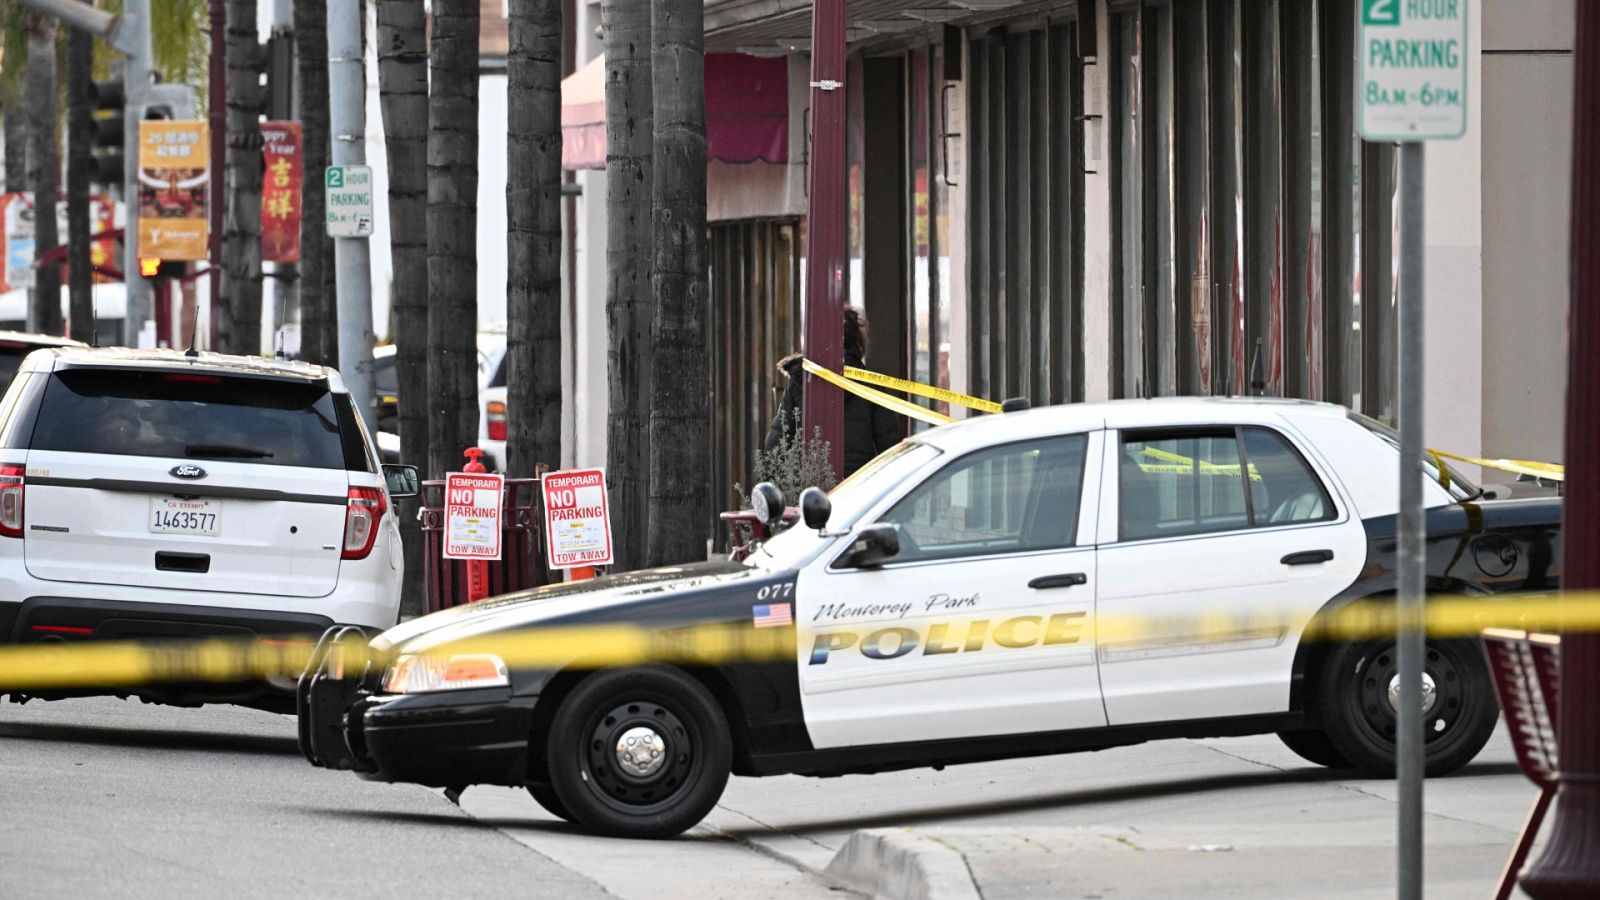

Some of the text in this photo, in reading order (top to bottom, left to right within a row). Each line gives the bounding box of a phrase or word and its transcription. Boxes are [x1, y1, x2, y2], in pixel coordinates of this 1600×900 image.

[1369, 0, 1458, 19] 2 HOUR
[1369, 39, 1458, 69] PARKING
[330, 169, 369, 186] 2 HOUR
[267, 156, 294, 220] 吉祥
[330, 192, 370, 206] PARKING
[177, 466, 200, 476] Ford
[451, 478, 499, 488] TEMPORARY
[548, 475, 600, 488] TEMPORARY
[451, 489, 472, 504] NO
[550, 490, 574, 508] NO
[180, 502, 204, 510] EXEMPT
[451, 506, 496, 518] PARKING
[552, 506, 602, 521] PARKING
[154, 510, 216, 531] 1463577
[451, 545, 495, 555] TOW AWAY
[556, 550, 605, 563] TOW AWAY
[757, 583, 794, 600] 077
[813, 593, 980, 621] Monterey Park
[808, 611, 1087, 666] POLICE
